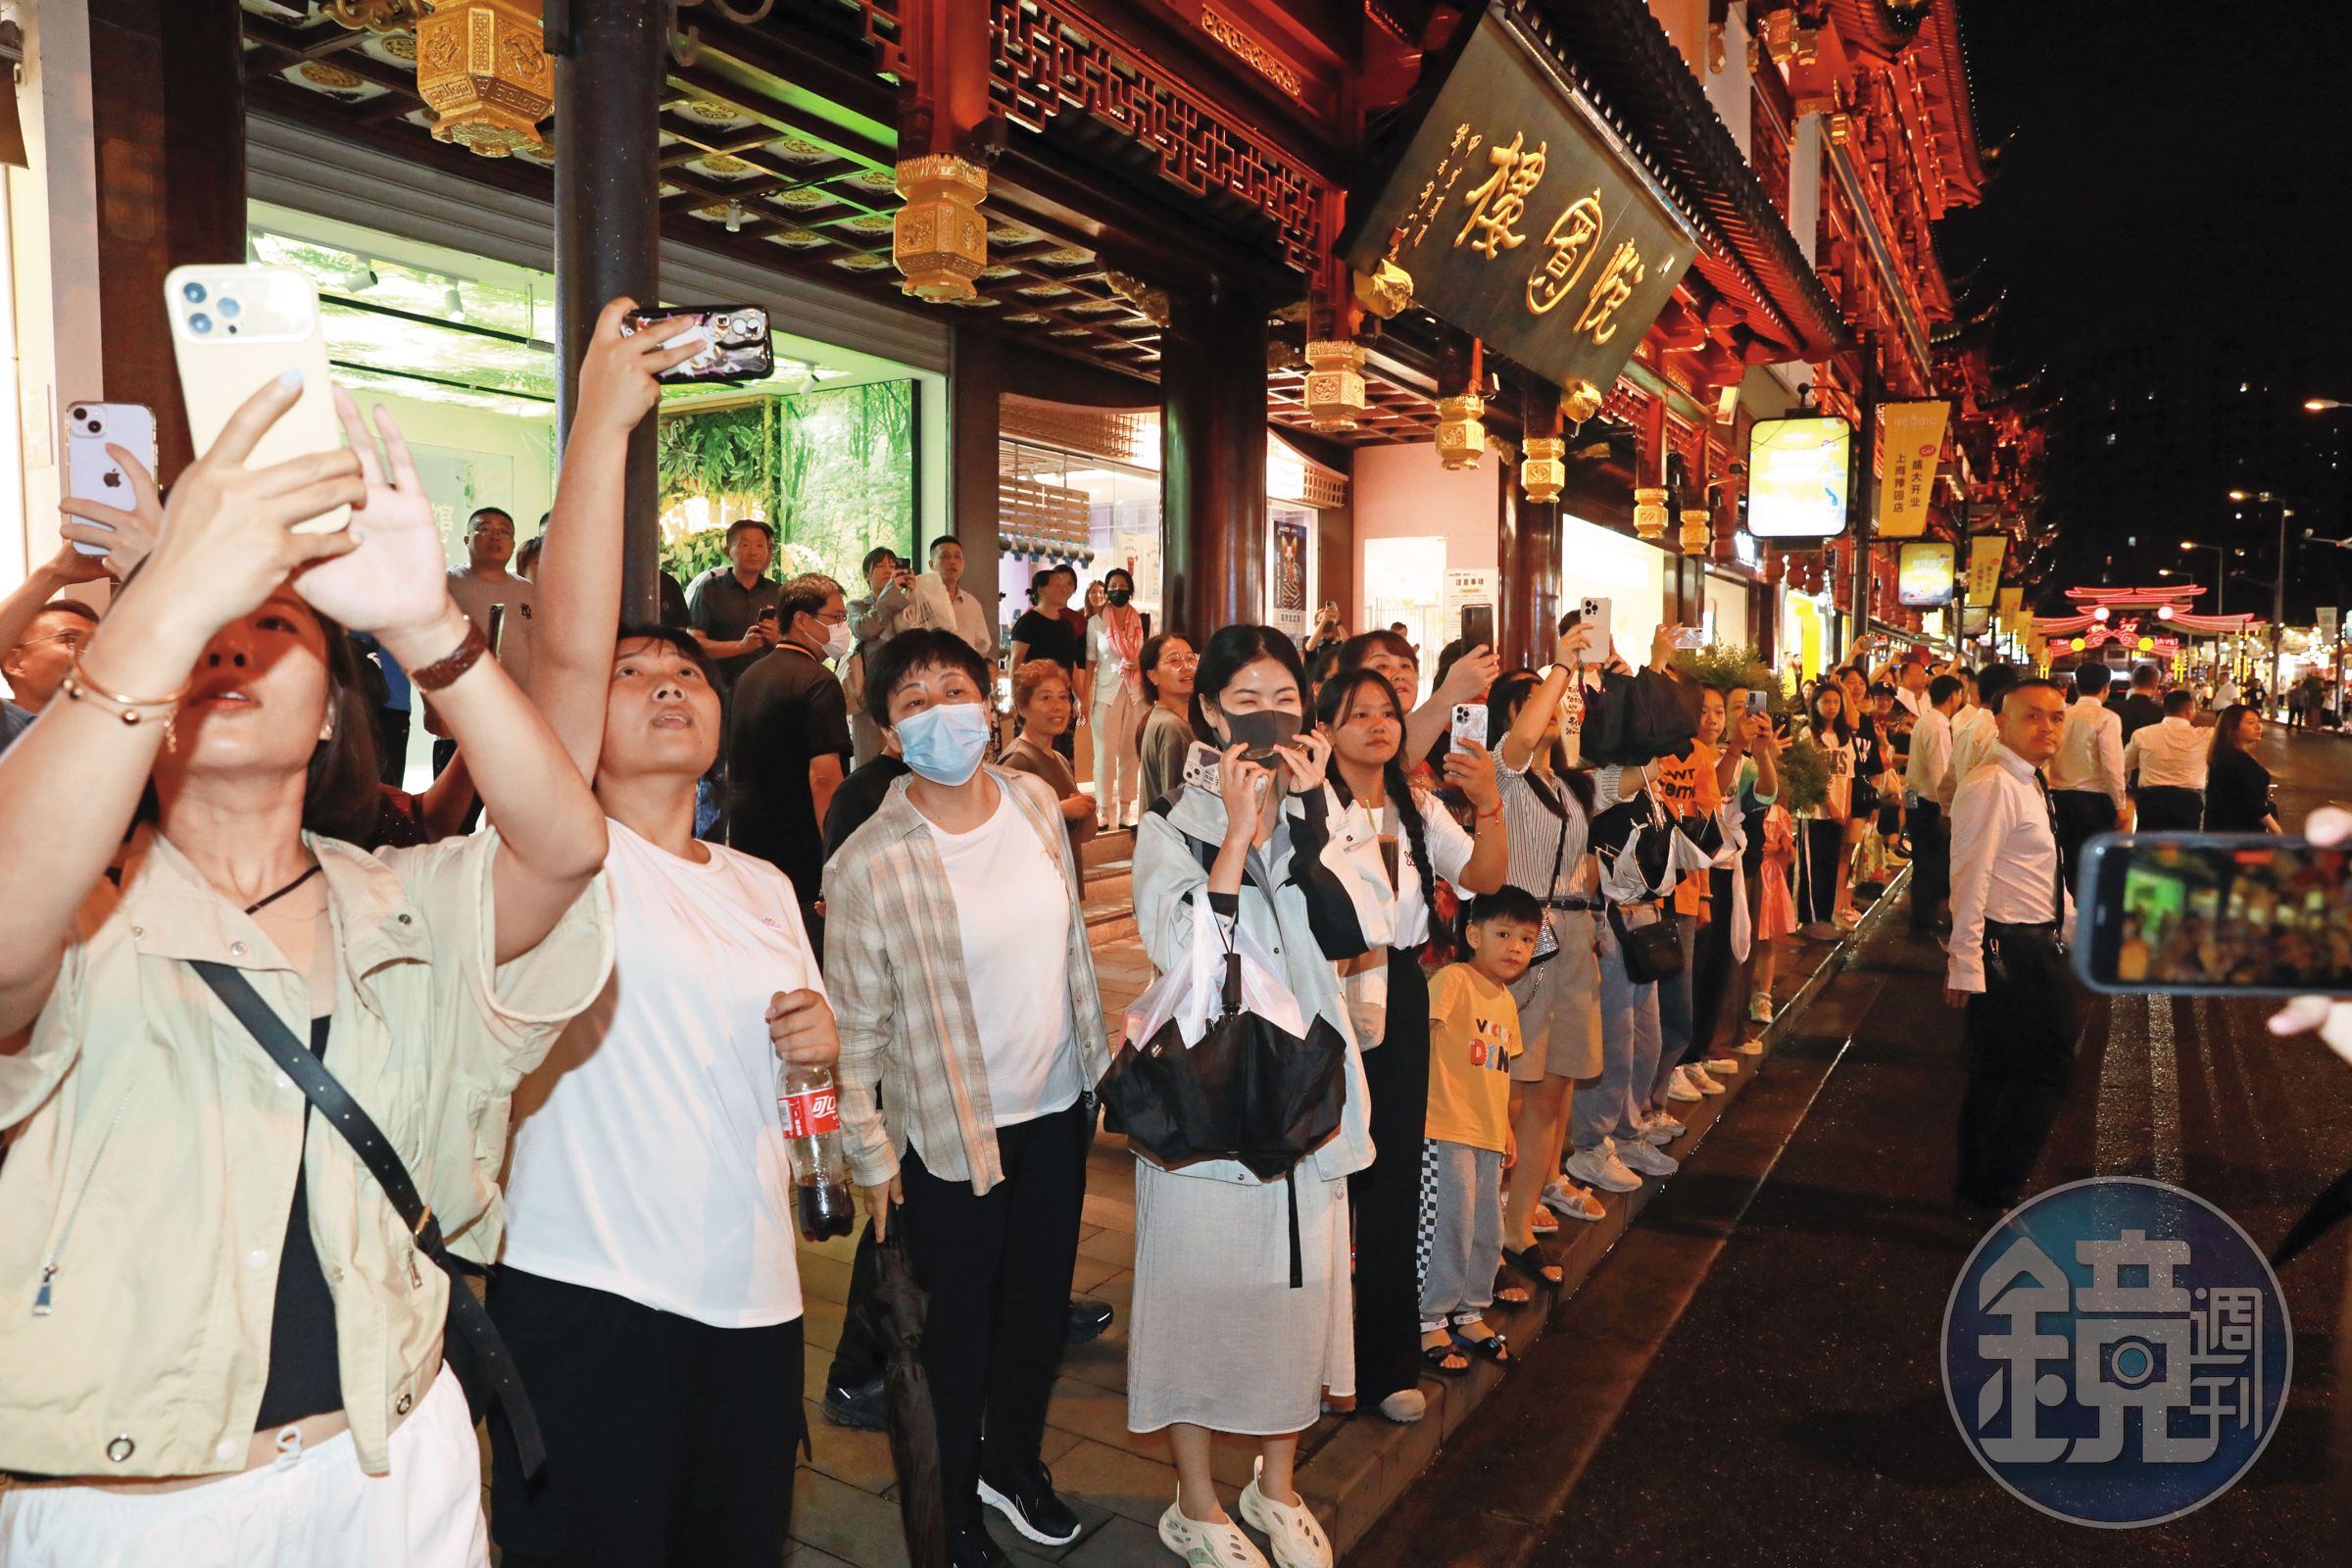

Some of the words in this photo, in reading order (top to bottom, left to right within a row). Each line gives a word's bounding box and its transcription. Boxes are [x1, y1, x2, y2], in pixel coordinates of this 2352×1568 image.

[1892, 453, 1906, 514] 上海豫园店
[1909, 460, 1923, 508] 盛大开业
